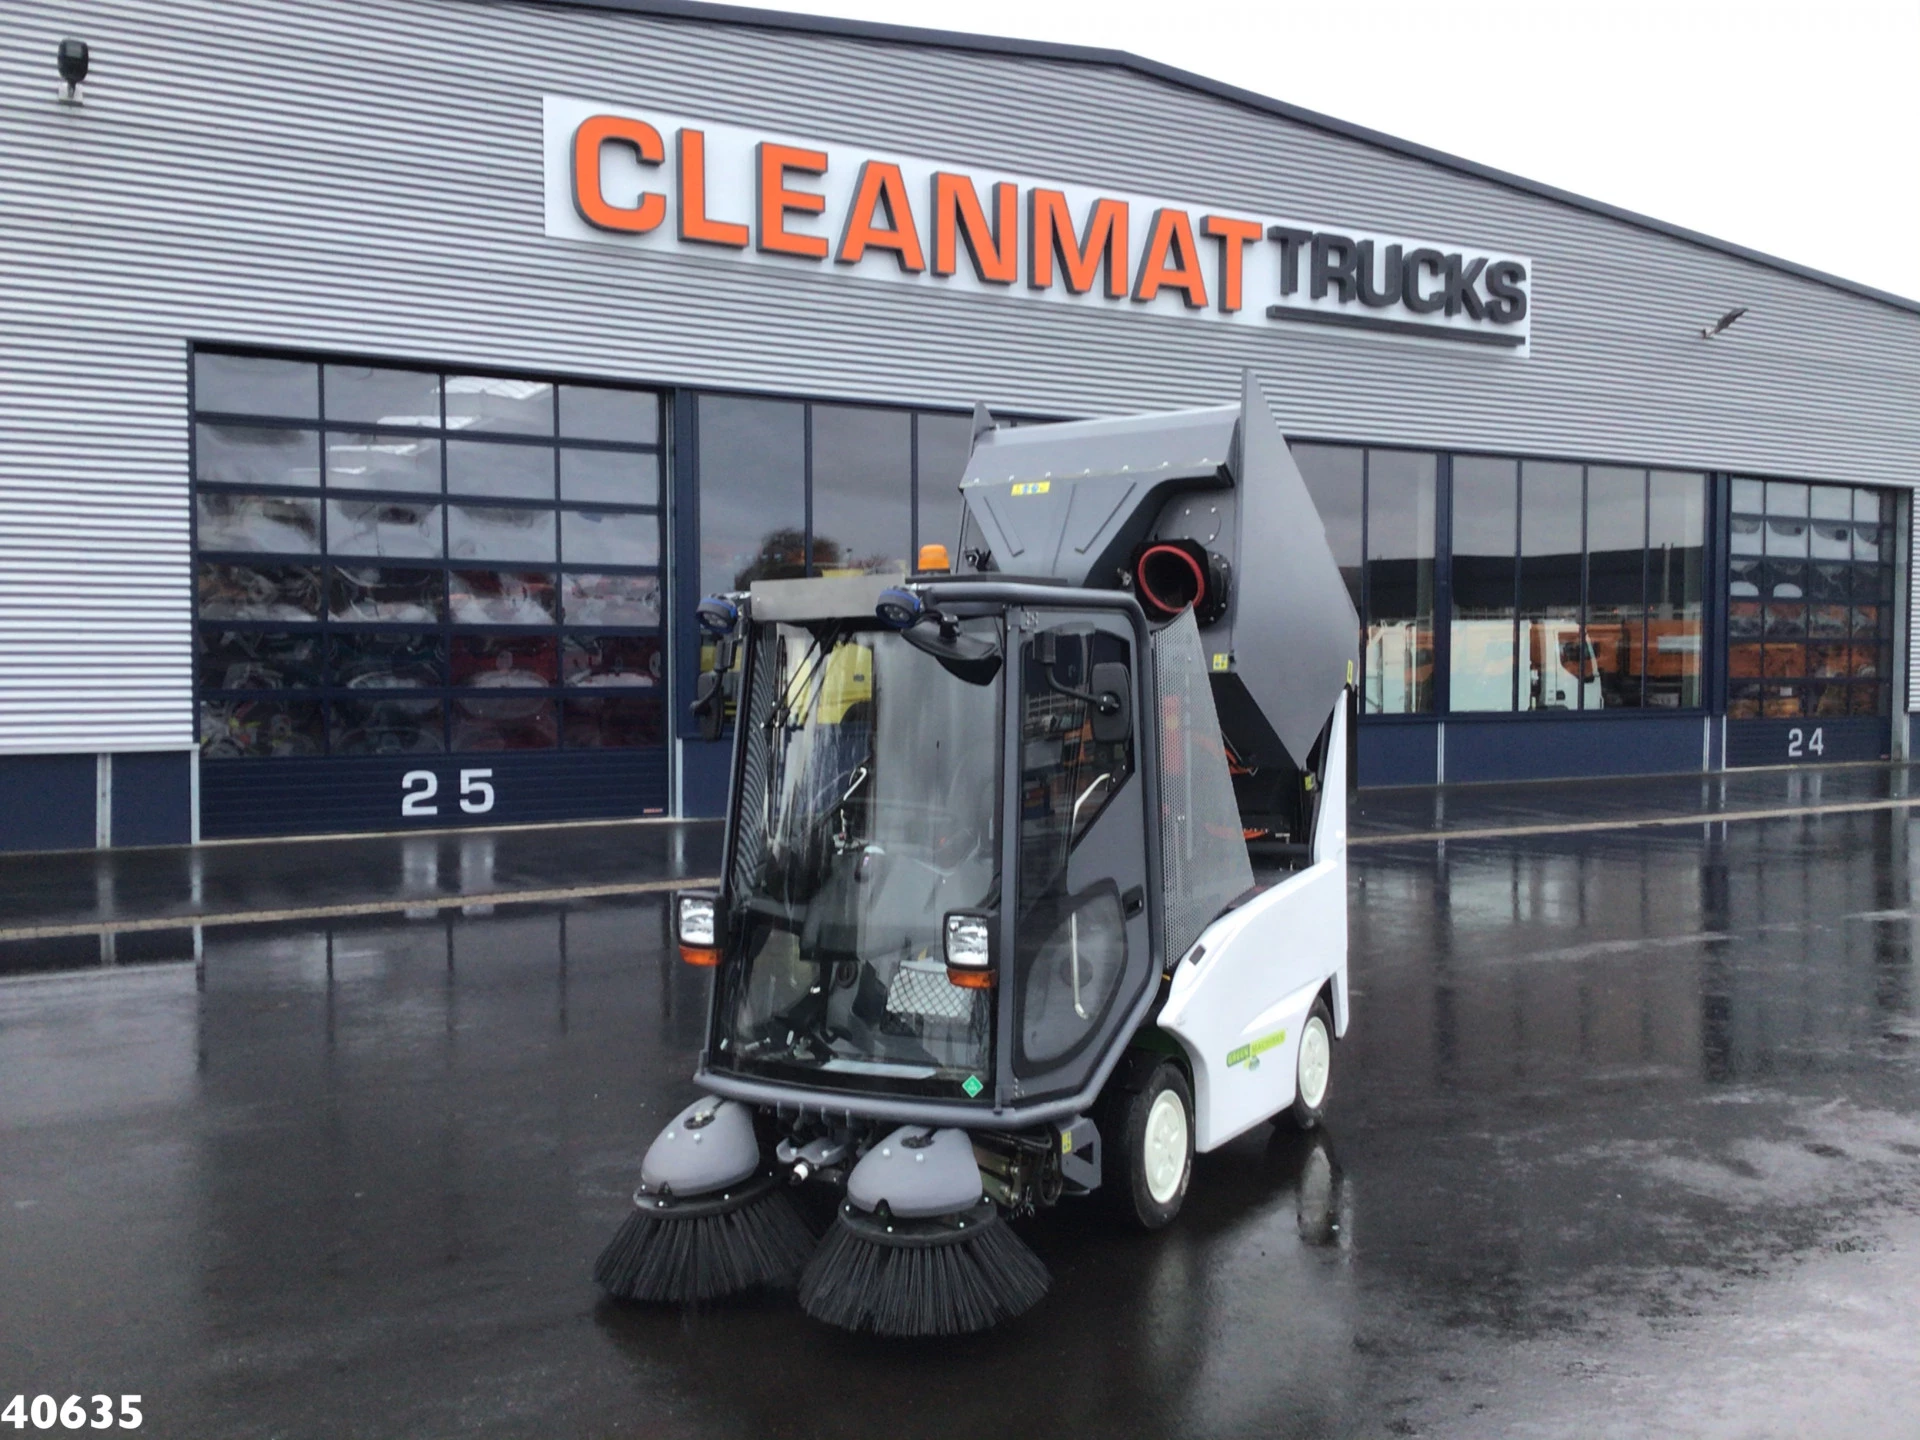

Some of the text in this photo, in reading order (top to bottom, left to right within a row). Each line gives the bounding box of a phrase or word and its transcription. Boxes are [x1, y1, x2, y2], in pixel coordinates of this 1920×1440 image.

[571, 114, 1527, 324] CLEANMAT TRUCKS
[1788, 727, 1824, 757] 24
[402, 768, 495, 816] 25
